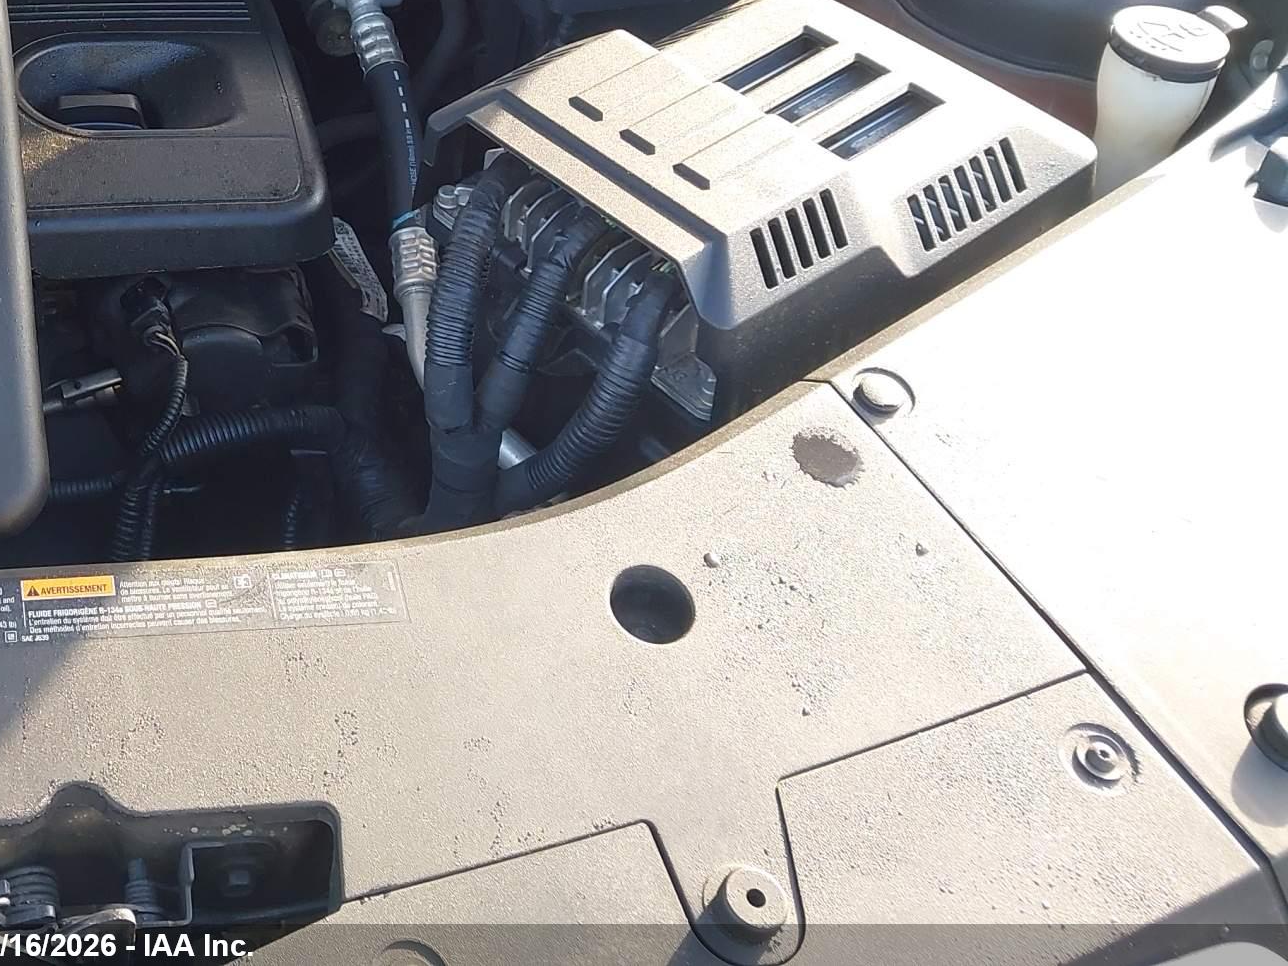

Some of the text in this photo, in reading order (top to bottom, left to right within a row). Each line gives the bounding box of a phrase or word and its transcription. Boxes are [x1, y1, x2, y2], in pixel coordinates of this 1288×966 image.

[41, 583, 108, 595] AVERTISSEMENT
[120, 588, 129, 596] de
[2, 596, 15, 604] and
[28, 609, 52, 618] FLUIDE
[63, 616, 71, 624] du
[29, 626, 42, 634] Des
